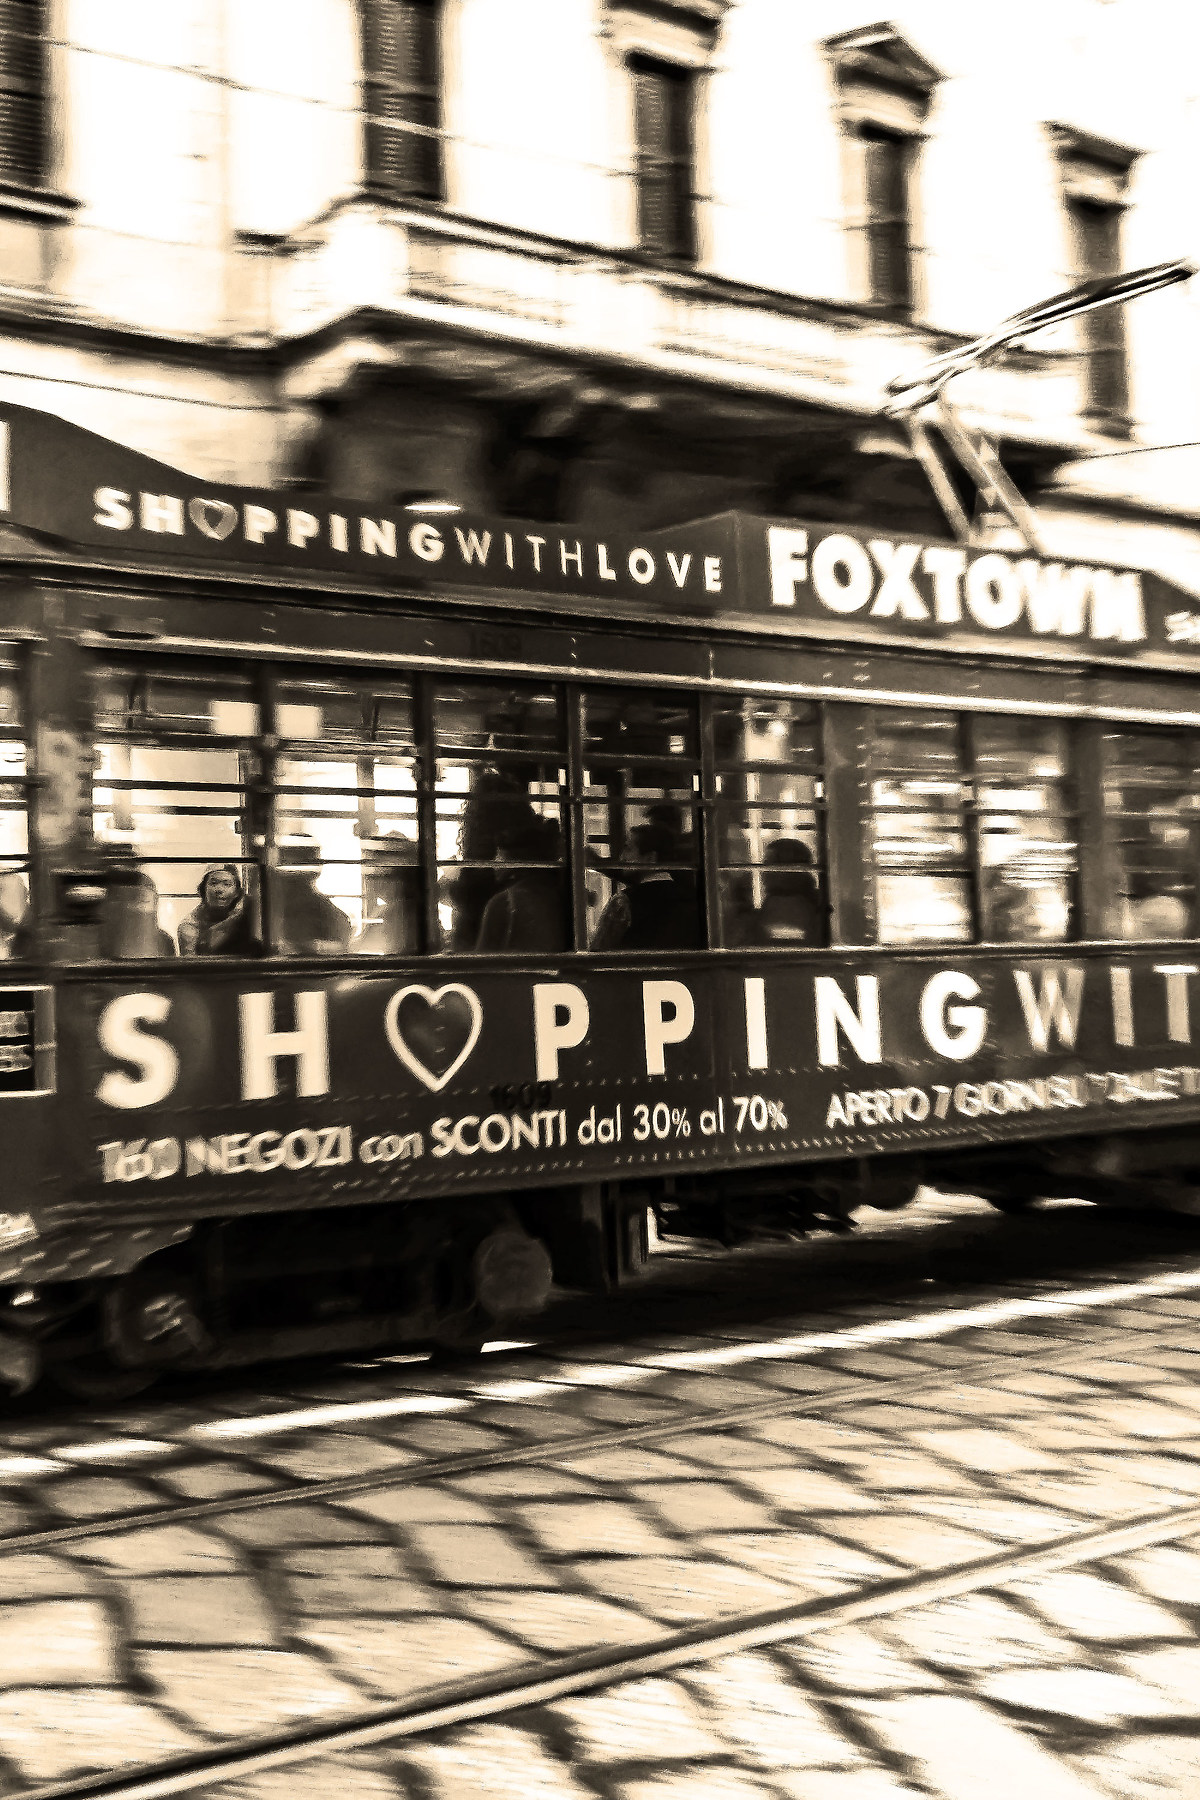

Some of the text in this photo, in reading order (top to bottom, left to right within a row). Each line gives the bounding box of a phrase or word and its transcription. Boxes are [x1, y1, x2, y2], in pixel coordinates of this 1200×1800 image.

[767, 525, 1147, 642] FOXTOWN
[185, 1125, 353, 1178] NEGOZI
[359, 1131, 424, 1165] con
[429, 1108, 568, 1158] SCONTI
[576, 1103, 623, 1147] dal
[632, 1100, 692, 1142] 30%
[698, 1095, 726, 1136] al
[731, 1093, 790, 1133] 70%
[824, 1085, 931, 1130] APERTO
[931, 1084, 953, 1121] 7
